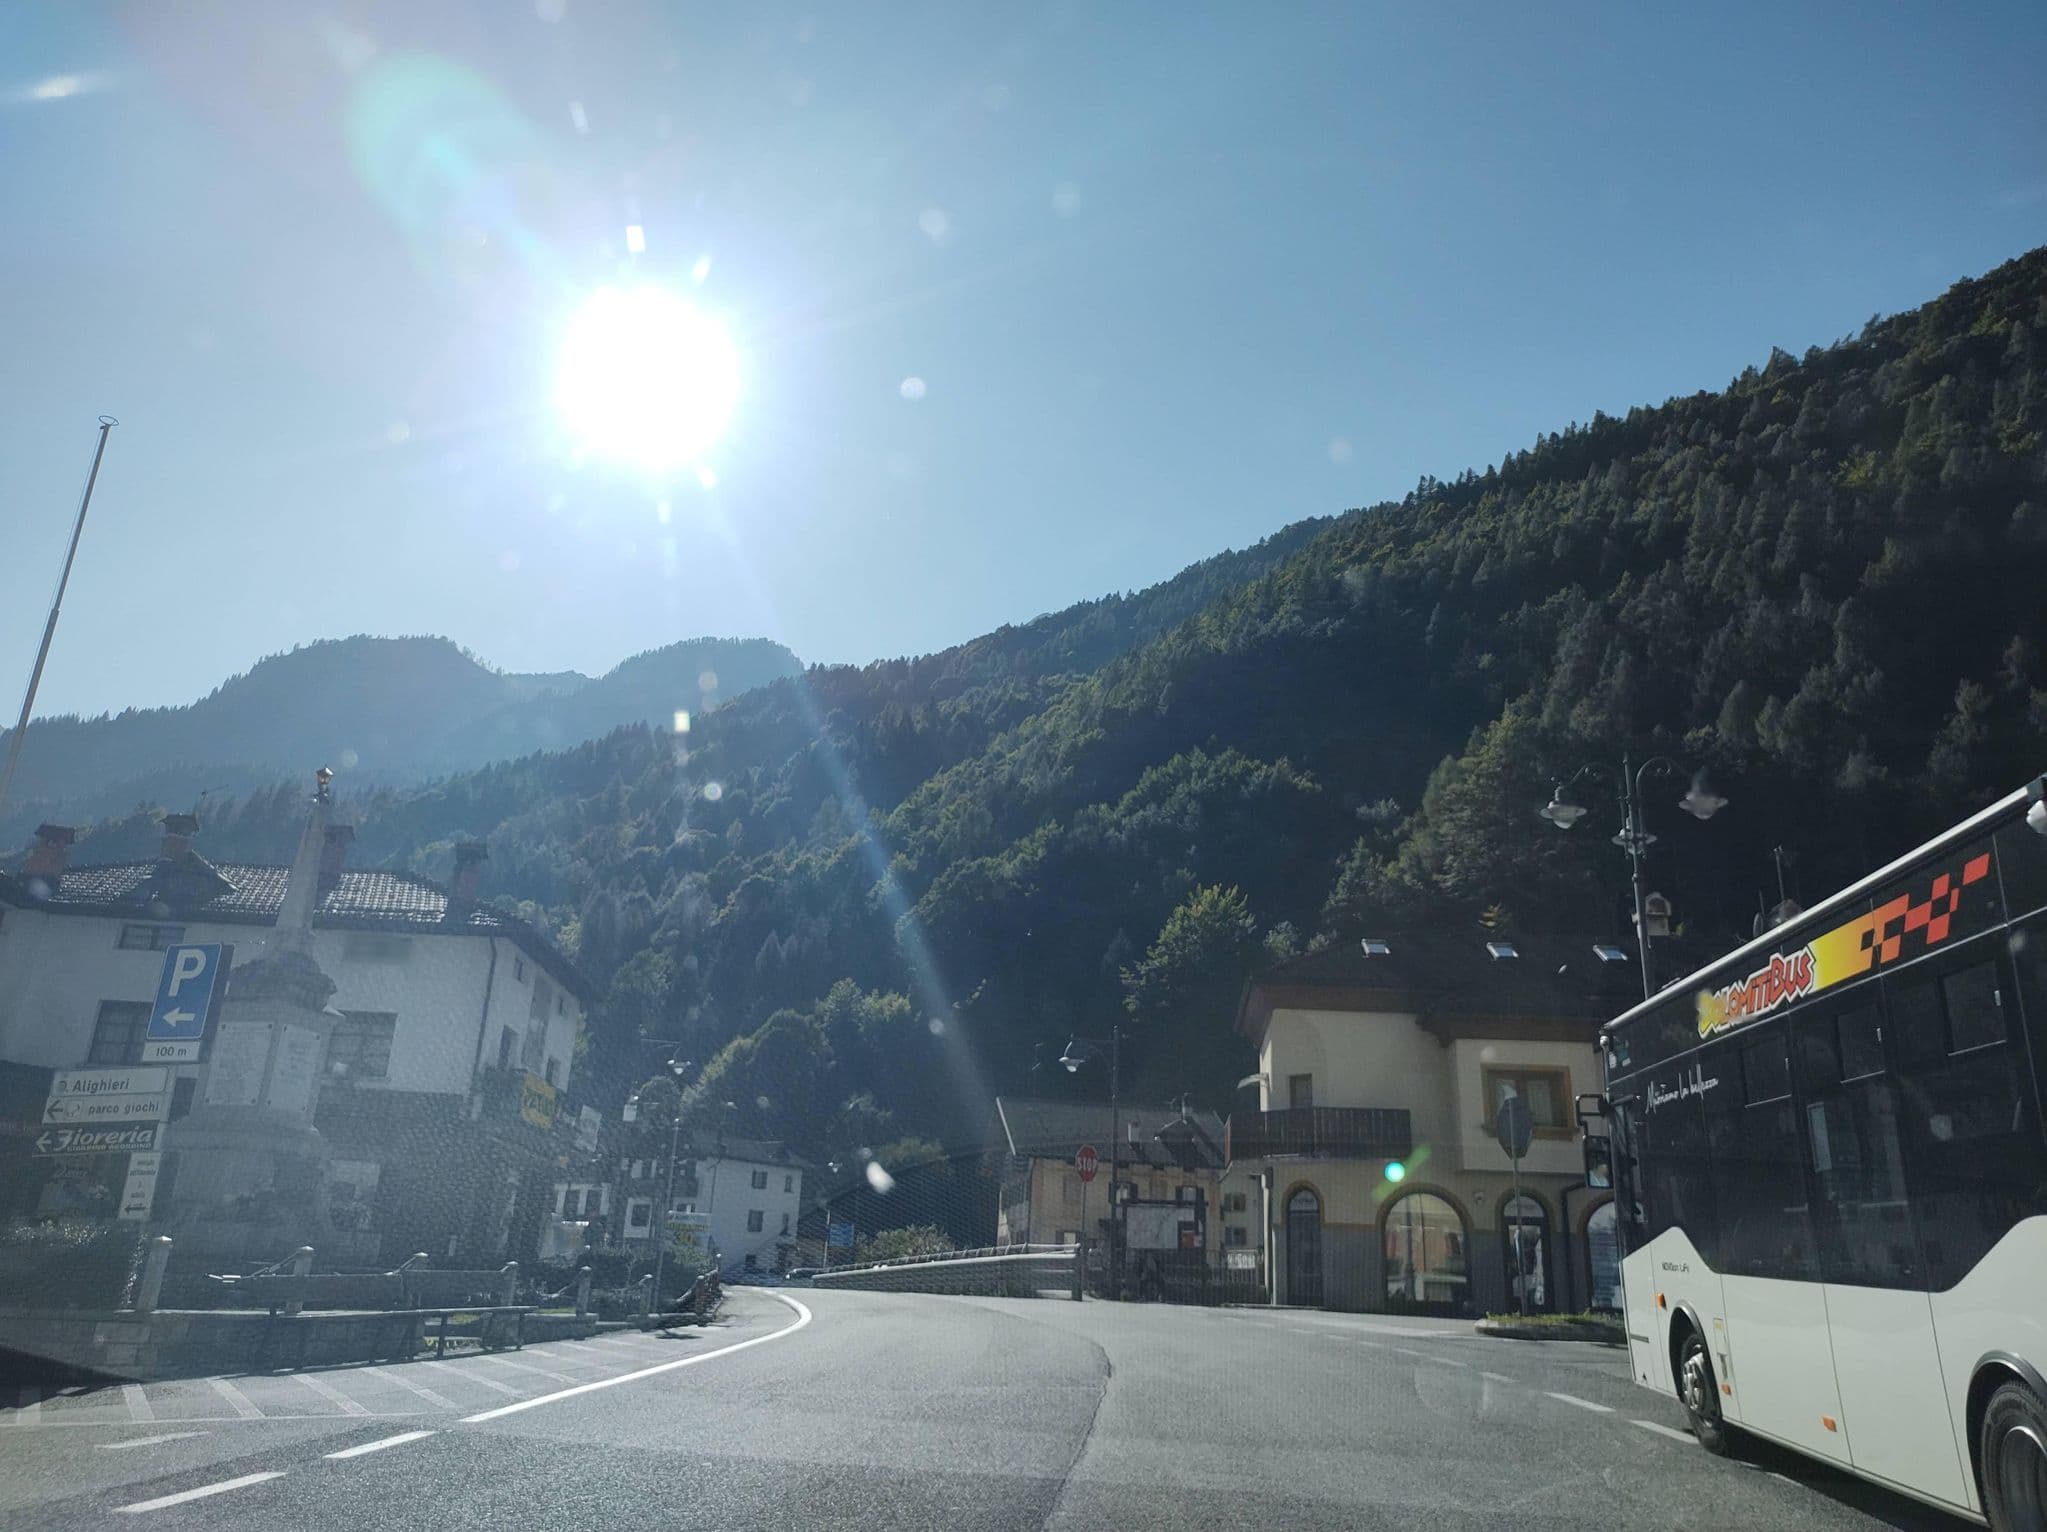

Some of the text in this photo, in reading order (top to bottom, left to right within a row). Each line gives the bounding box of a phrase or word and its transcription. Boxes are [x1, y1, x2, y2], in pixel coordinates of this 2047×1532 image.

[168, 949, 206, 997] P
[156, 1046, 187, 1057] 100 m
[71, 1078, 130, 1094] Alighieri
[88, 1101, 159, 1117] parco giochi
[53, 1126, 153, 1151] Fioreria
[1076, 1157, 1098, 1170] STOP
